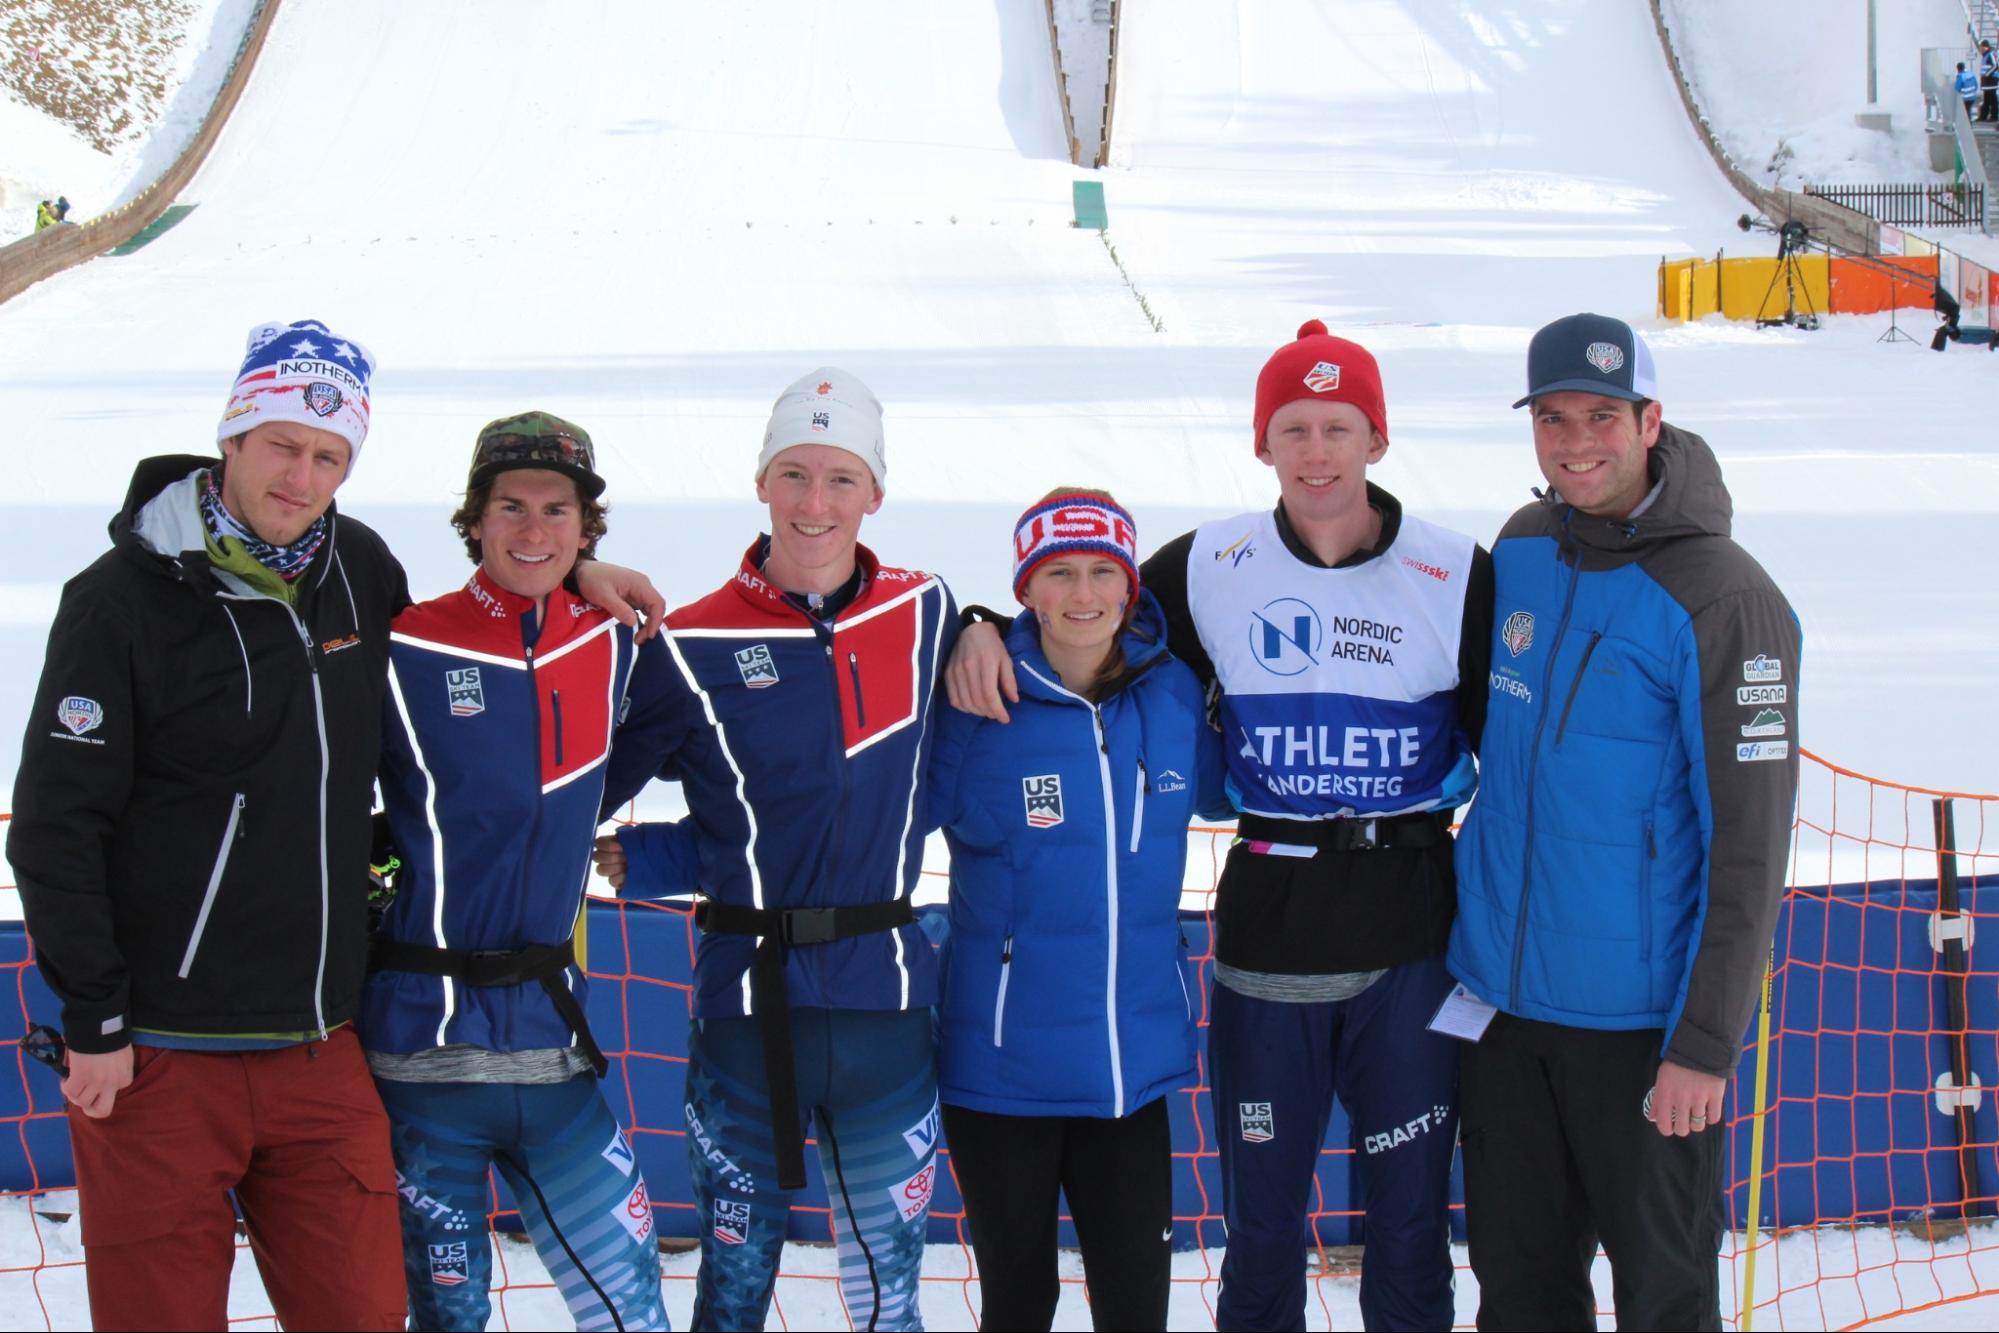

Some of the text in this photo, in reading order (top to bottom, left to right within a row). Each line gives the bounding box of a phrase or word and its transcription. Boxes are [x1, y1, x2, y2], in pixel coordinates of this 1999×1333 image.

[280, 361, 362, 397] INOTHERM
[813, 412, 830, 420] US
[1016, 507, 1136, 562] USA
[466, 577, 494, 608] RAFT
[1333, 616, 1404, 644] NORDIC
[735, 646, 768, 664] US
[1331, 641, 1394, 667] ARENA
[448, 670, 479, 685] US
[1489, 672, 1532, 703] NOTHERM
[71, 700, 92, 711] USA
[1740, 688, 1785, 702] USANA
[1240, 726, 1420, 767] ATHLETE
[1739, 744, 1760, 759] efi
[1025, 777, 1058, 795] US
[1257, 774, 1404, 798] ANDERSTEG
[1241, 1104, 1270, 1117] US
[685, 1102, 740, 1175] CRAFT
[1365, 1113, 1431, 1154] CRAFT
[716, 1200, 748, 1218] US
[430, 1244, 465, 1259] US
